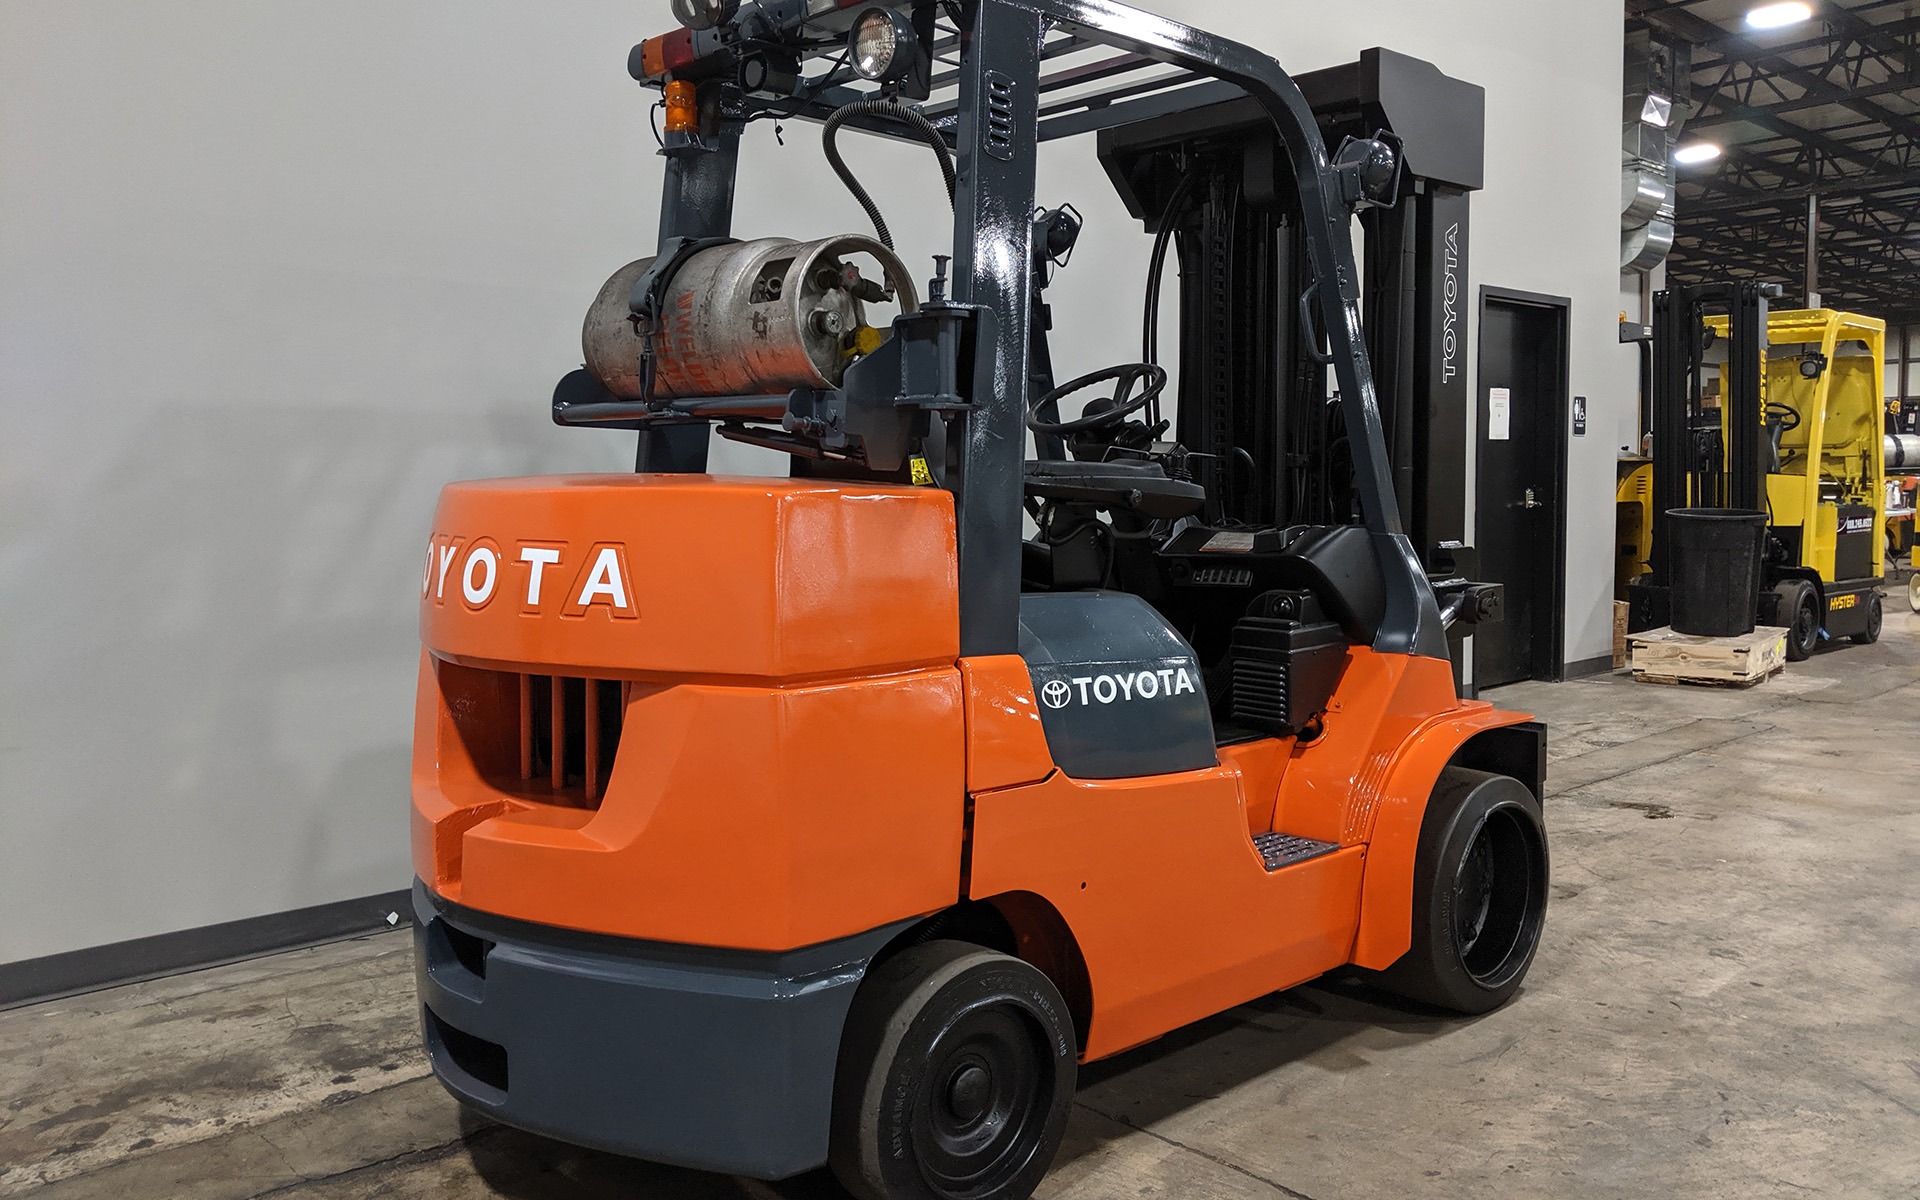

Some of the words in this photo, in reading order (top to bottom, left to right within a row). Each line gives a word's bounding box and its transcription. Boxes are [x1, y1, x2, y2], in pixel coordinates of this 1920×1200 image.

[1443, 223, 1458, 383] TOYOTA
[1829, 594, 1855, 611] HYSTER
[1072, 668, 1195, 706] TOYOTA
